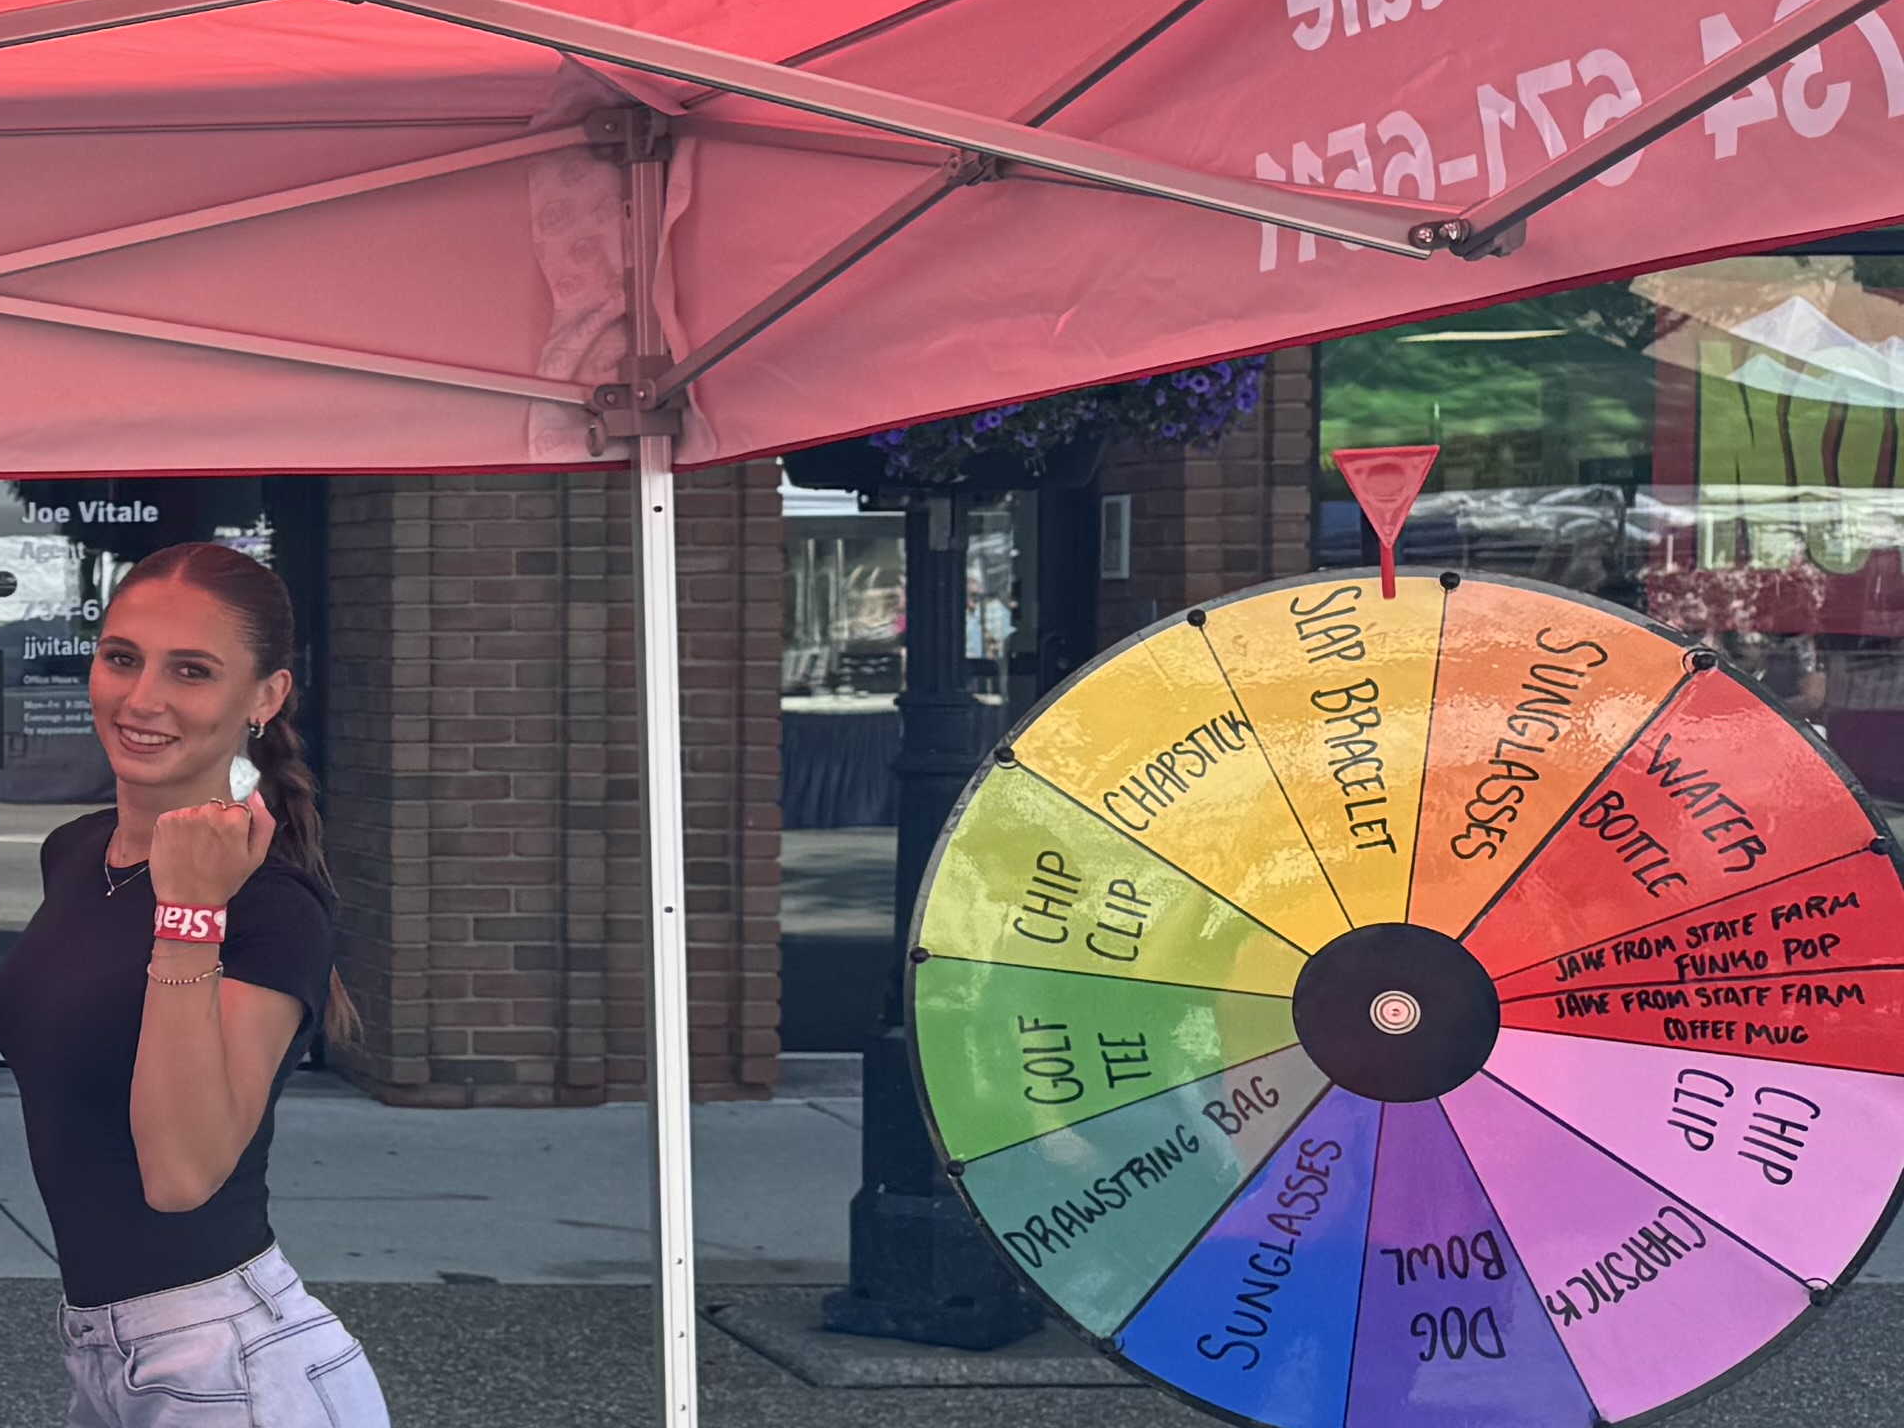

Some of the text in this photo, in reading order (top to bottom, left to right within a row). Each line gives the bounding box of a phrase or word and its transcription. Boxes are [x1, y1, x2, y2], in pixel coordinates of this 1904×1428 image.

[21, 500, 159, 523] Joe Vitale
[20, 598, 100, 622] 734-6
[1289, 583, 1399, 855] SLAP BRACELET
[1450, 626, 1607, 862] SUNGLASSES
[1102, 708, 1252, 833] CHAPSTICK
[1643, 733, 1769, 875] WATER
[1579, 788, 1686, 899] BOTTLE
[1012, 849, 1082, 944] CHIP
[1086, 877, 1150, 963] CLIP
[1612, 935, 1676, 965] FROM
[1686, 913, 1757, 949] STATE
[1771, 892, 1861, 930] FARM
[1621, 989, 1690, 1014] FROM
[1694, 986, 1772, 1008] STATE
[1782, 983, 1866, 1007] FARM
[1674, 933, 1841, 983] FUNKO POP
[1022, 1013, 1085, 1107] GOLF
[1106, 1030, 1149, 1090] TEE
[1663, 1017, 1809, 1045] COFFEE MUG
[1667, 1068, 1734, 1152] CLIP
[1737, 1086, 1822, 1185] CHIP
[1003, 1074, 1281, 1270] DRAWSTRING BAG
[1197, 1137, 1342, 1371] SUNGLASSES
[1380, 1228, 1508, 1284] BOWL
[1545, 1202, 1706, 1329] CHAPSTICK
[1412, 1307, 1506, 1361] DOG
